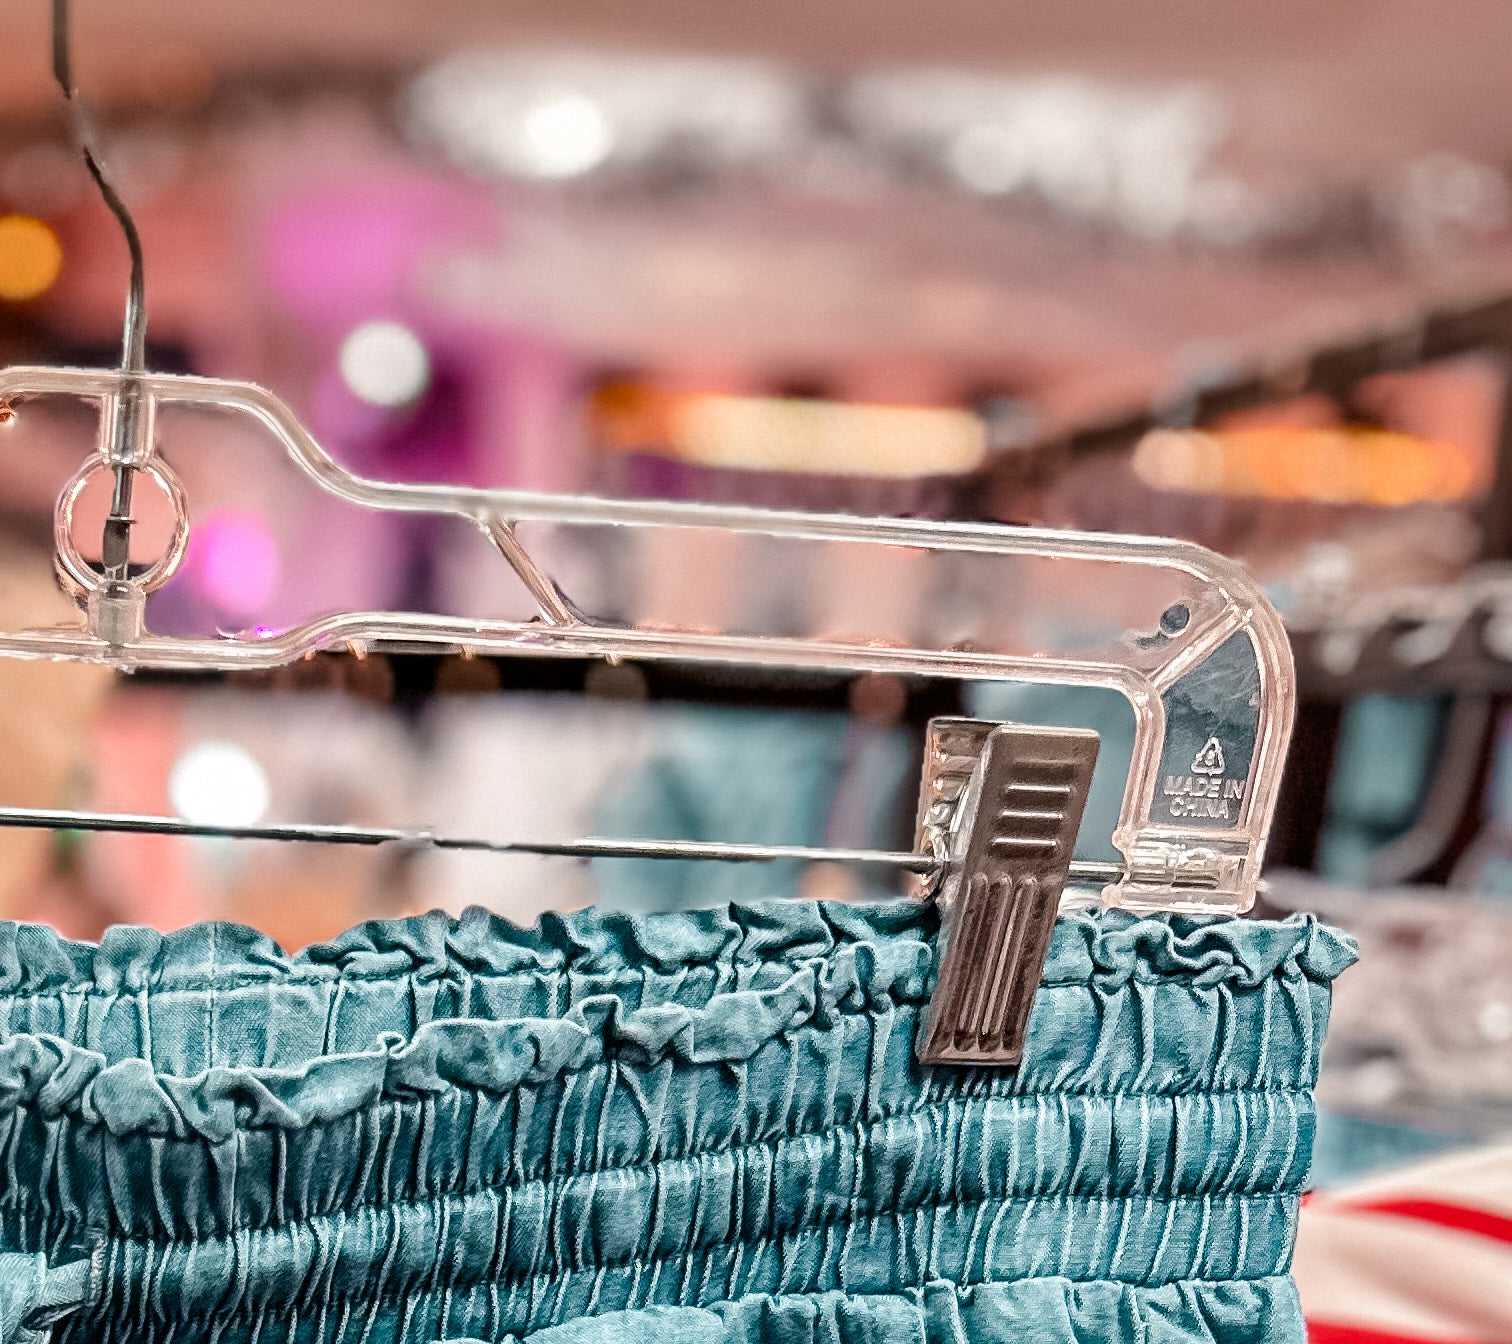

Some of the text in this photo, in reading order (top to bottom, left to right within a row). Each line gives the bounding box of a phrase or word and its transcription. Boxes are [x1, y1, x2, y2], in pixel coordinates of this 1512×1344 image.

[1164, 775, 1245, 799] MADE IN
[1170, 798, 1229, 819] CHINA
